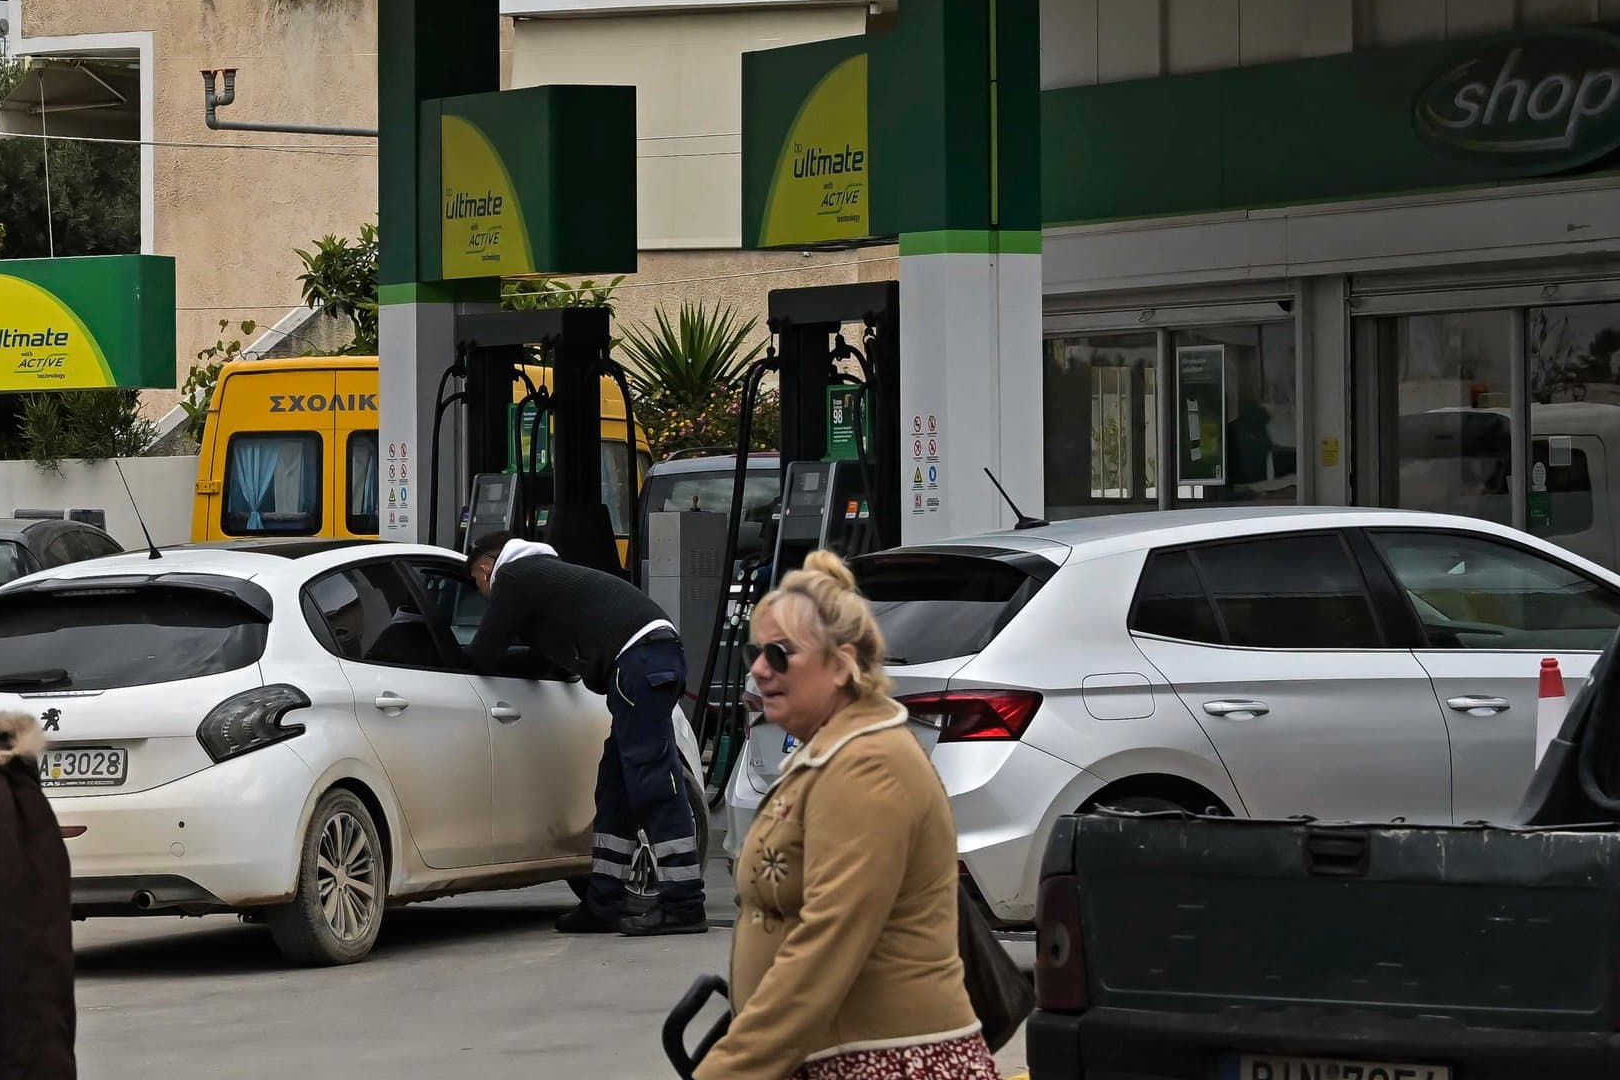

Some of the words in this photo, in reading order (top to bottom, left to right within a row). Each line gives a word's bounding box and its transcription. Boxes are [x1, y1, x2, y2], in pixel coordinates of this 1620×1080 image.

[1446, 48, 1620, 140] shop
[794, 144, 864, 178] ultimate
[446, 190, 503, 219] ultimate
[820, 190, 860, 207] ACTIVE
[468, 232, 500, 247] ACTIVE
[18, 358, 64, 368] ACTIVE
[269, 394, 378, 412] ΣΧΟΛΙΚ
[833, 409, 843, 424] 98
[40, 752, 120, 777] A-3028
